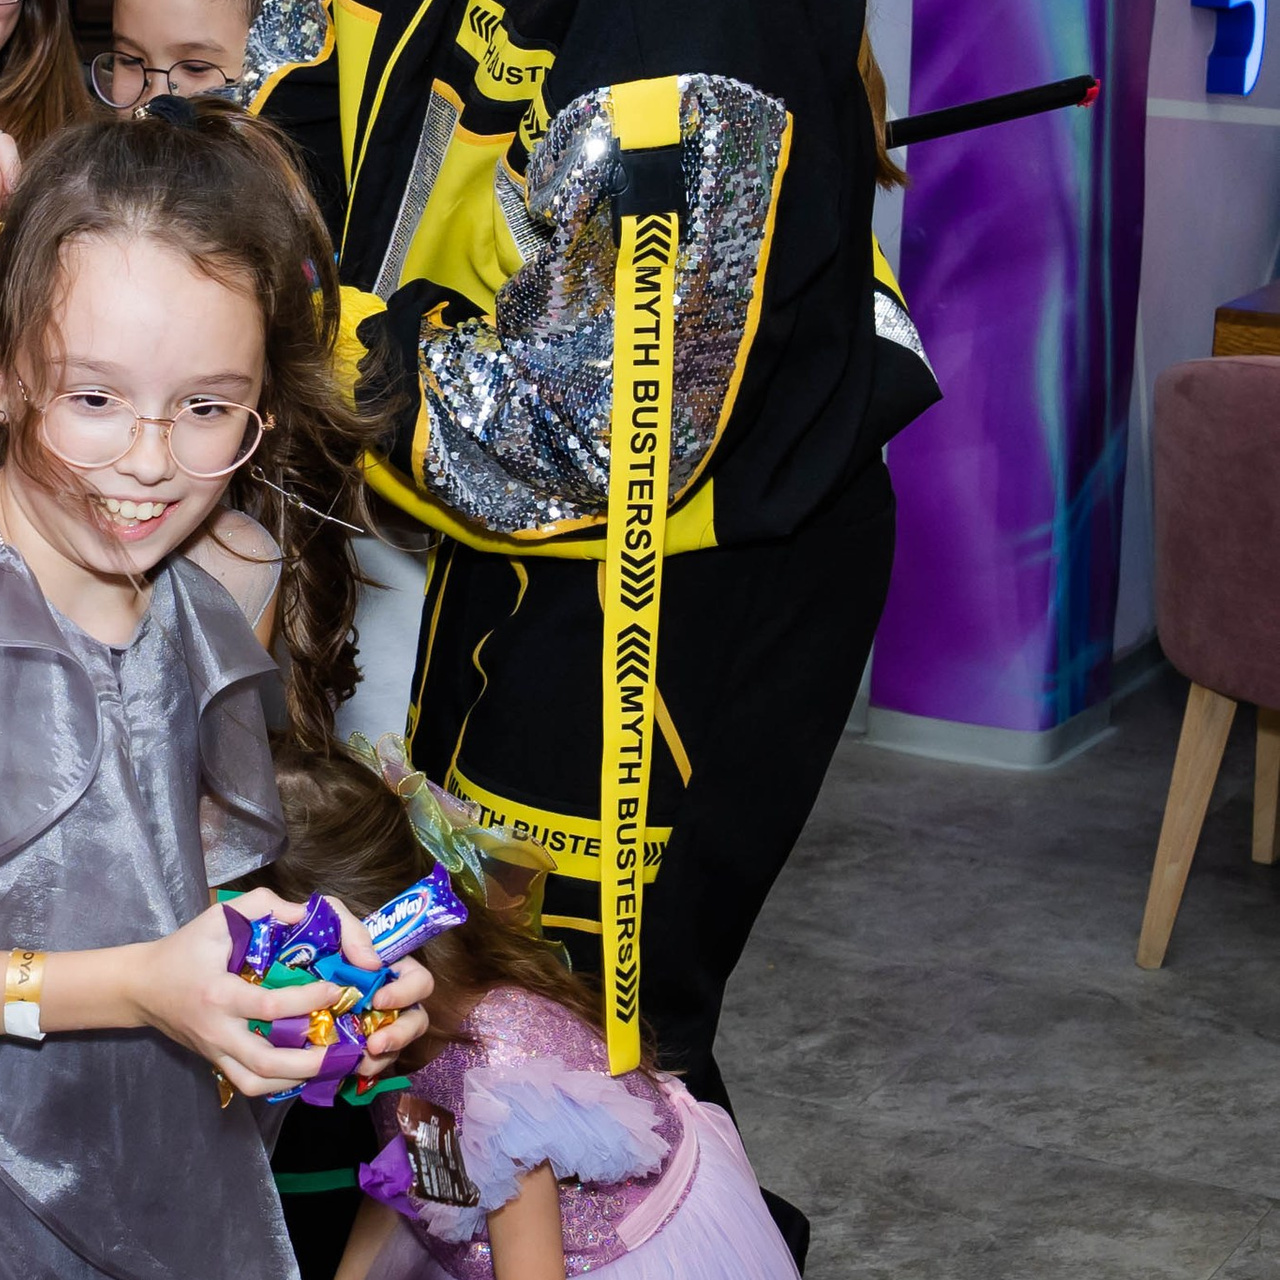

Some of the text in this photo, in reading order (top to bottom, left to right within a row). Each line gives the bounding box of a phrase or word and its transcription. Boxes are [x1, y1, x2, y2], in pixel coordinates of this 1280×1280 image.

[624, 266, 661, 551] MYTH BUSTERS
[511, 820, 601, 857] BUSTE
[615, 685, 644, 966] MYTH BUSTERS
[18, 951, 35, 985] OYA
